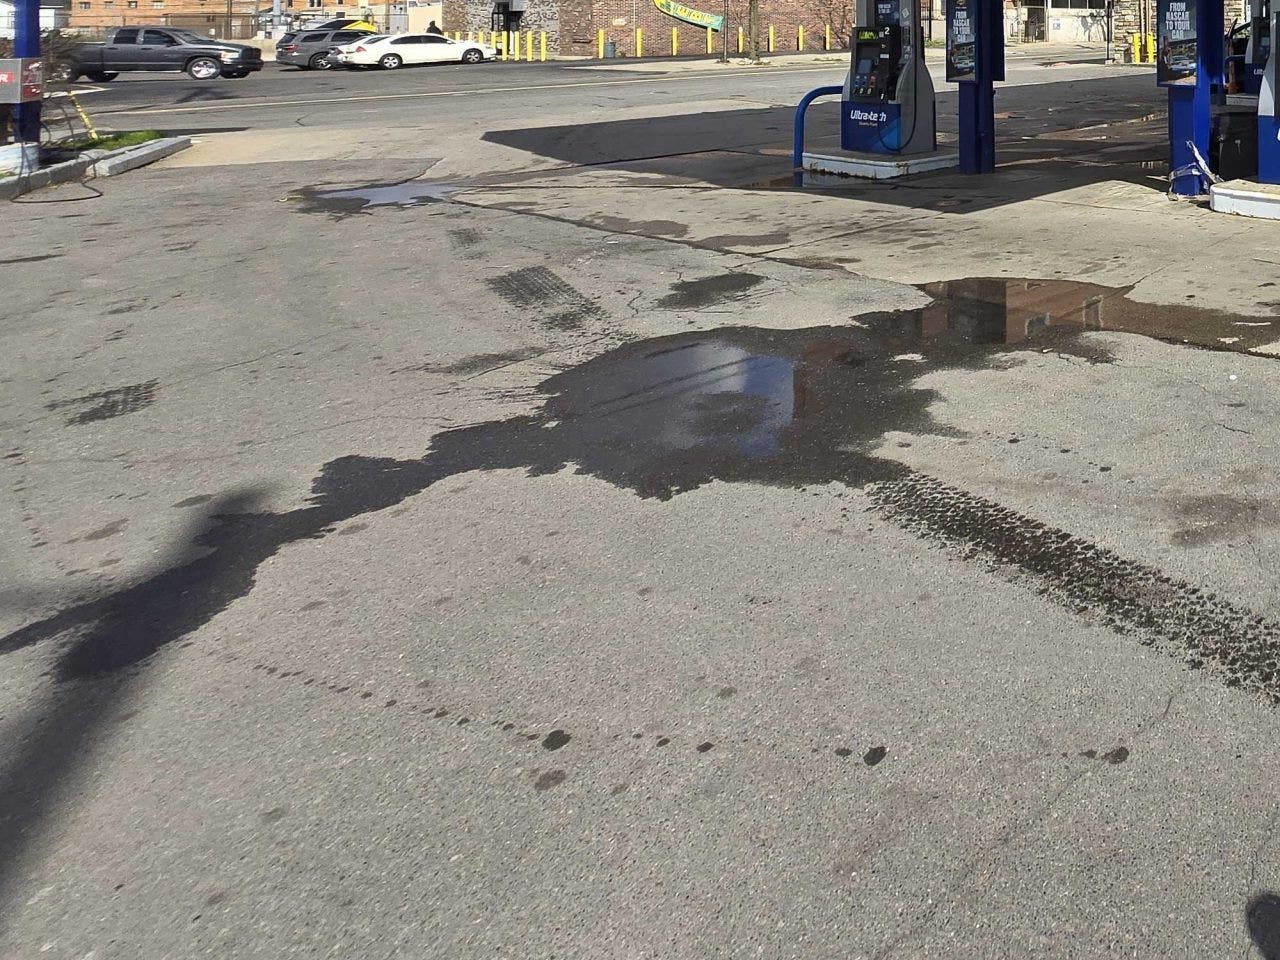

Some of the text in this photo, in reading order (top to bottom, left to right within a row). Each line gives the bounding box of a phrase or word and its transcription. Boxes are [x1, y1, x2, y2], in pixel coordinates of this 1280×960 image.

[1169, 2, 1186, 11] FROM
[1165, 11, 1190, 21] NASCAR
[1165, 21, 1190, 30] TO YOUR
[884, 26, 890, 35] 2
